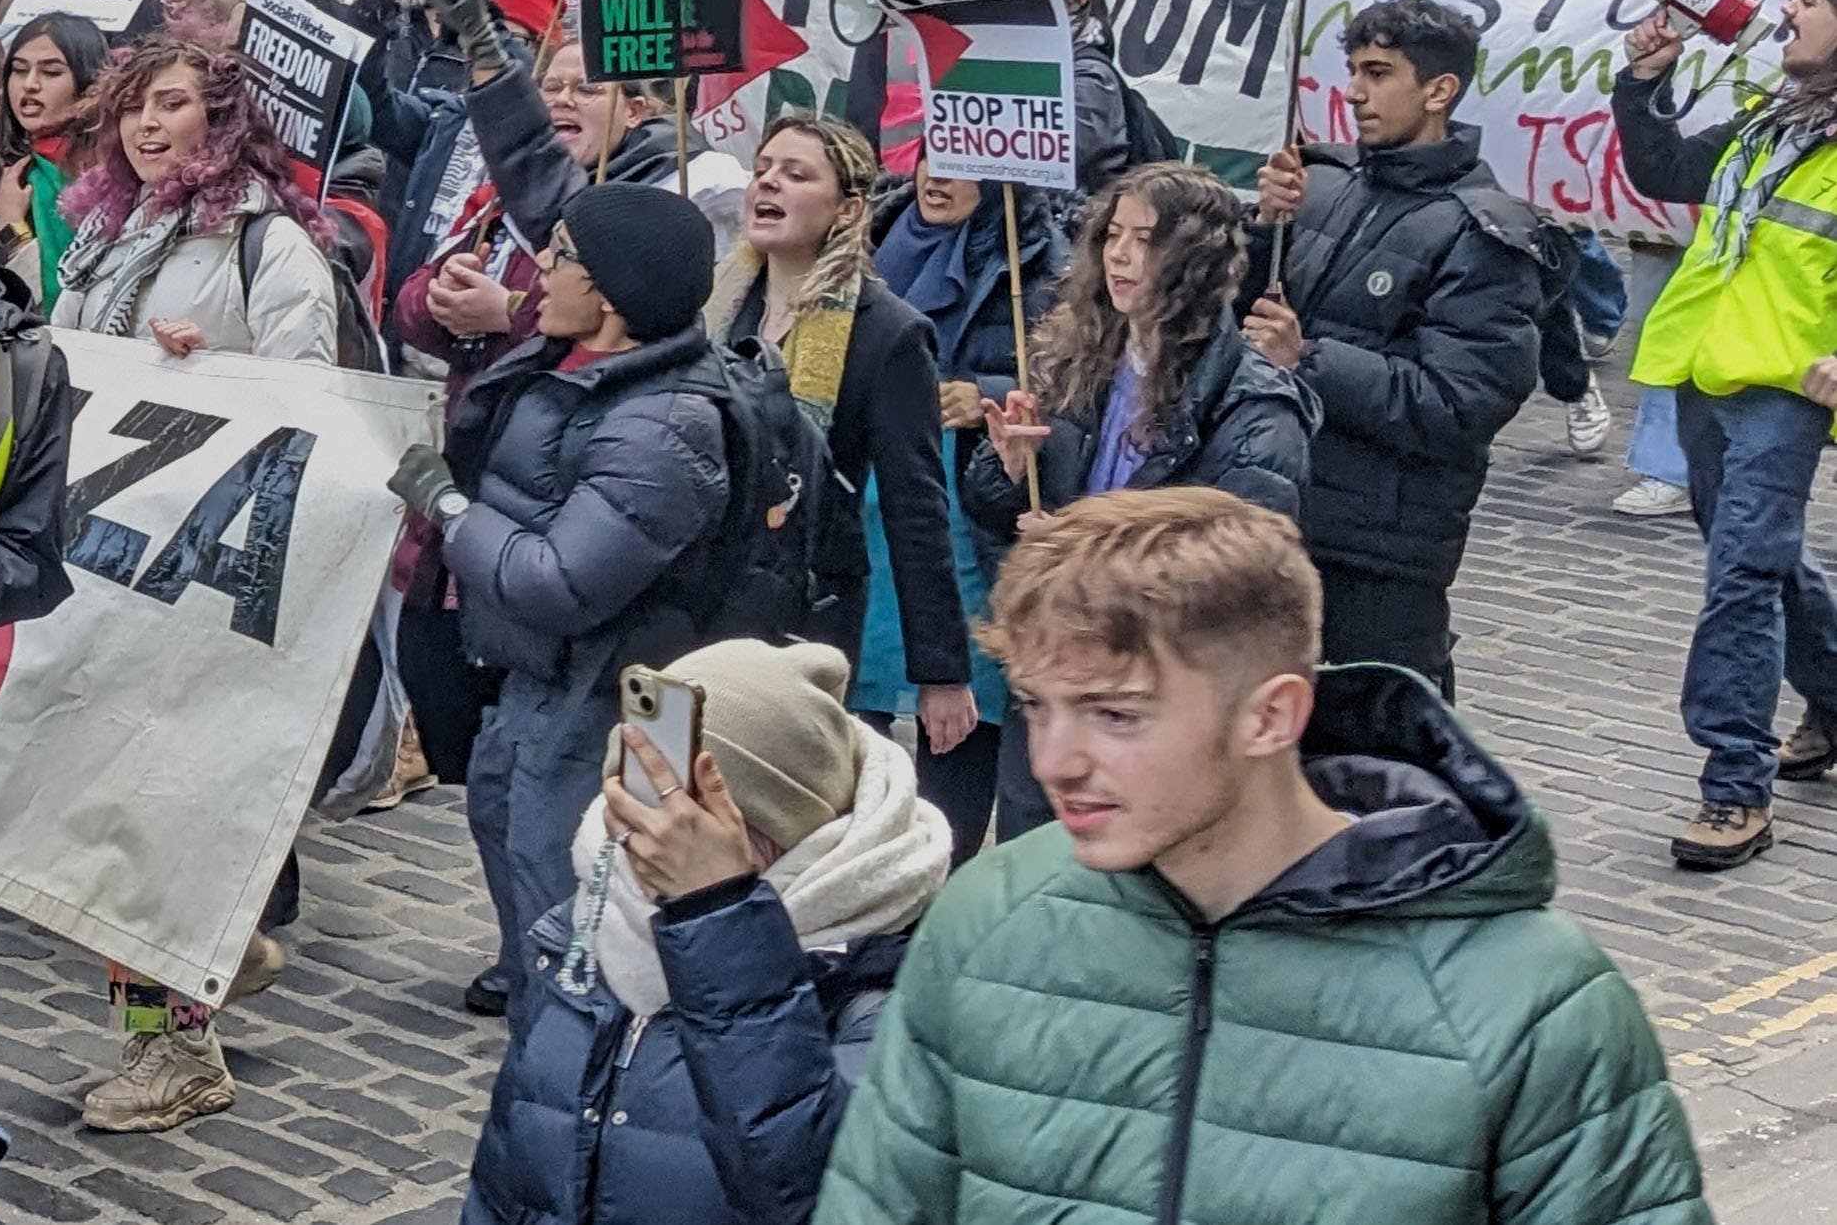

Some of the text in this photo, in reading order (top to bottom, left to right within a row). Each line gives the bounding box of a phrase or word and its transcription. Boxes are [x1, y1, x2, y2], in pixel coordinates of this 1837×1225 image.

[298, 14, 336, 46] Worker
[244, 18, 332, 99] FREEDOM
[602, 32, 677, 73] FREE
[932, 93, 1065, 131] STOP THE
[928, 124, 1071, 164] GENOCIDE
